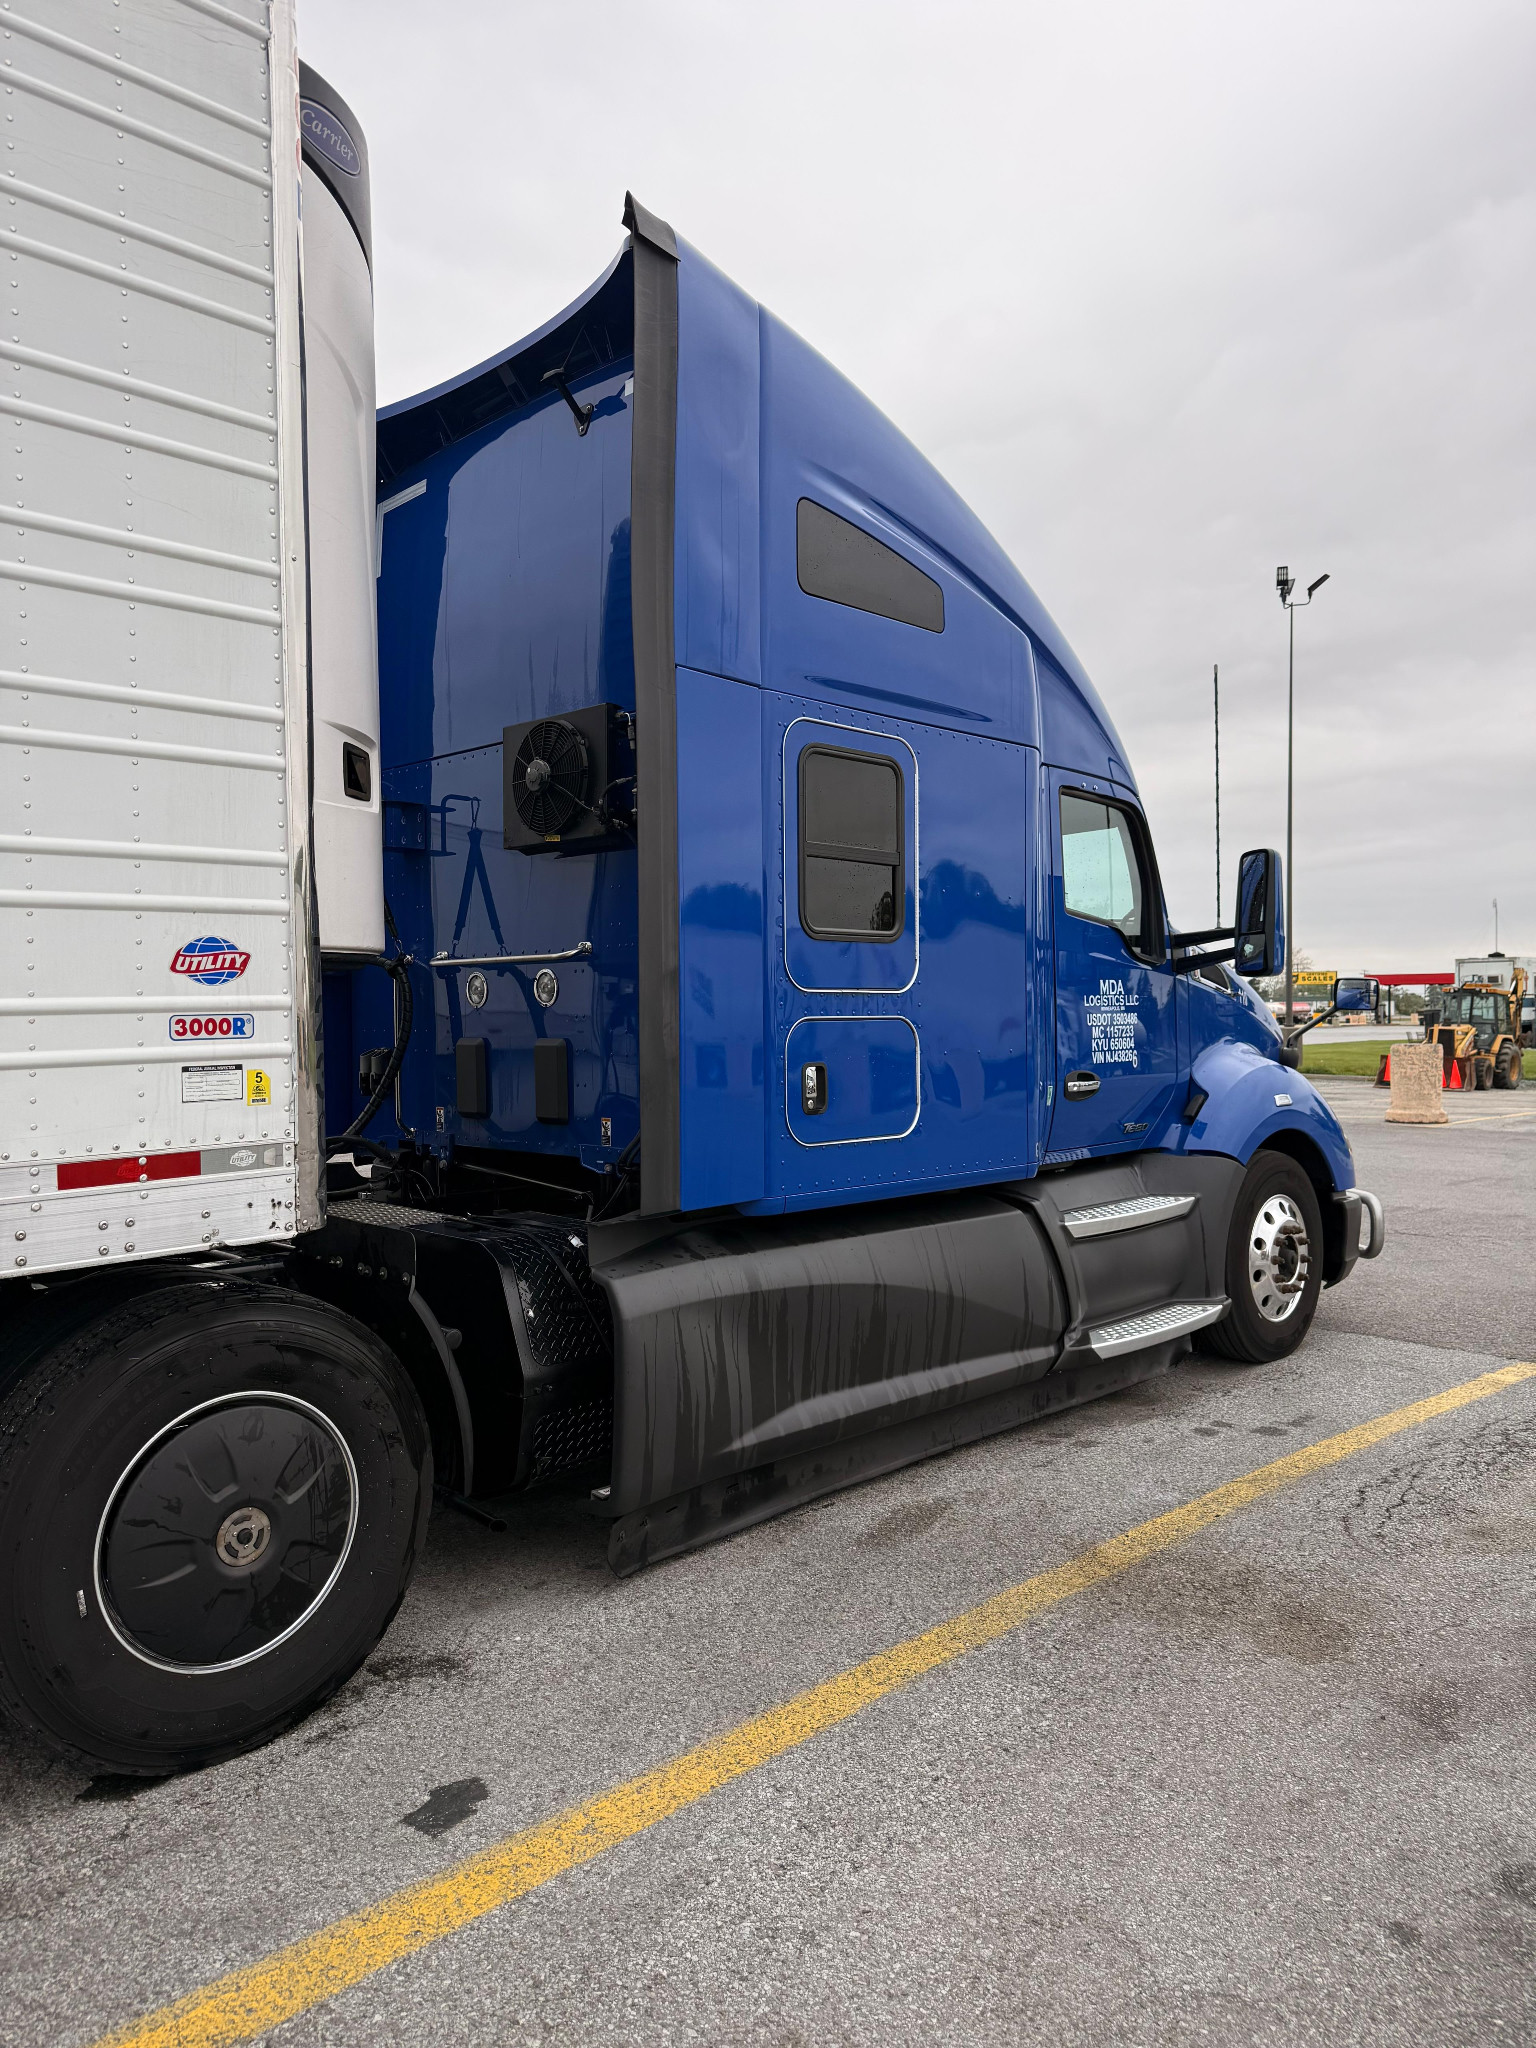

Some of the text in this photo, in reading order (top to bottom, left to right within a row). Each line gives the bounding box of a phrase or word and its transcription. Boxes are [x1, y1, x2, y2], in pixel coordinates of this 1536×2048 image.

[301, 109, 354, 161] Carrier
[175, 953, 247, 971] UTILITY
[1100, 980, 1124, 994] MDA
[1084, 994, 1140, 1007] LOGISTICS LLC
[1086, 1012, 1138, 1026] USDOT 3503486
[1091, 1025, 1135, 1039] MC 1157233
[1091, 1036, 1135, 1052] KYU 650604
[1091, 1051, 1105, 1065] VIN
[255, 1072, 263, 1084] 5
